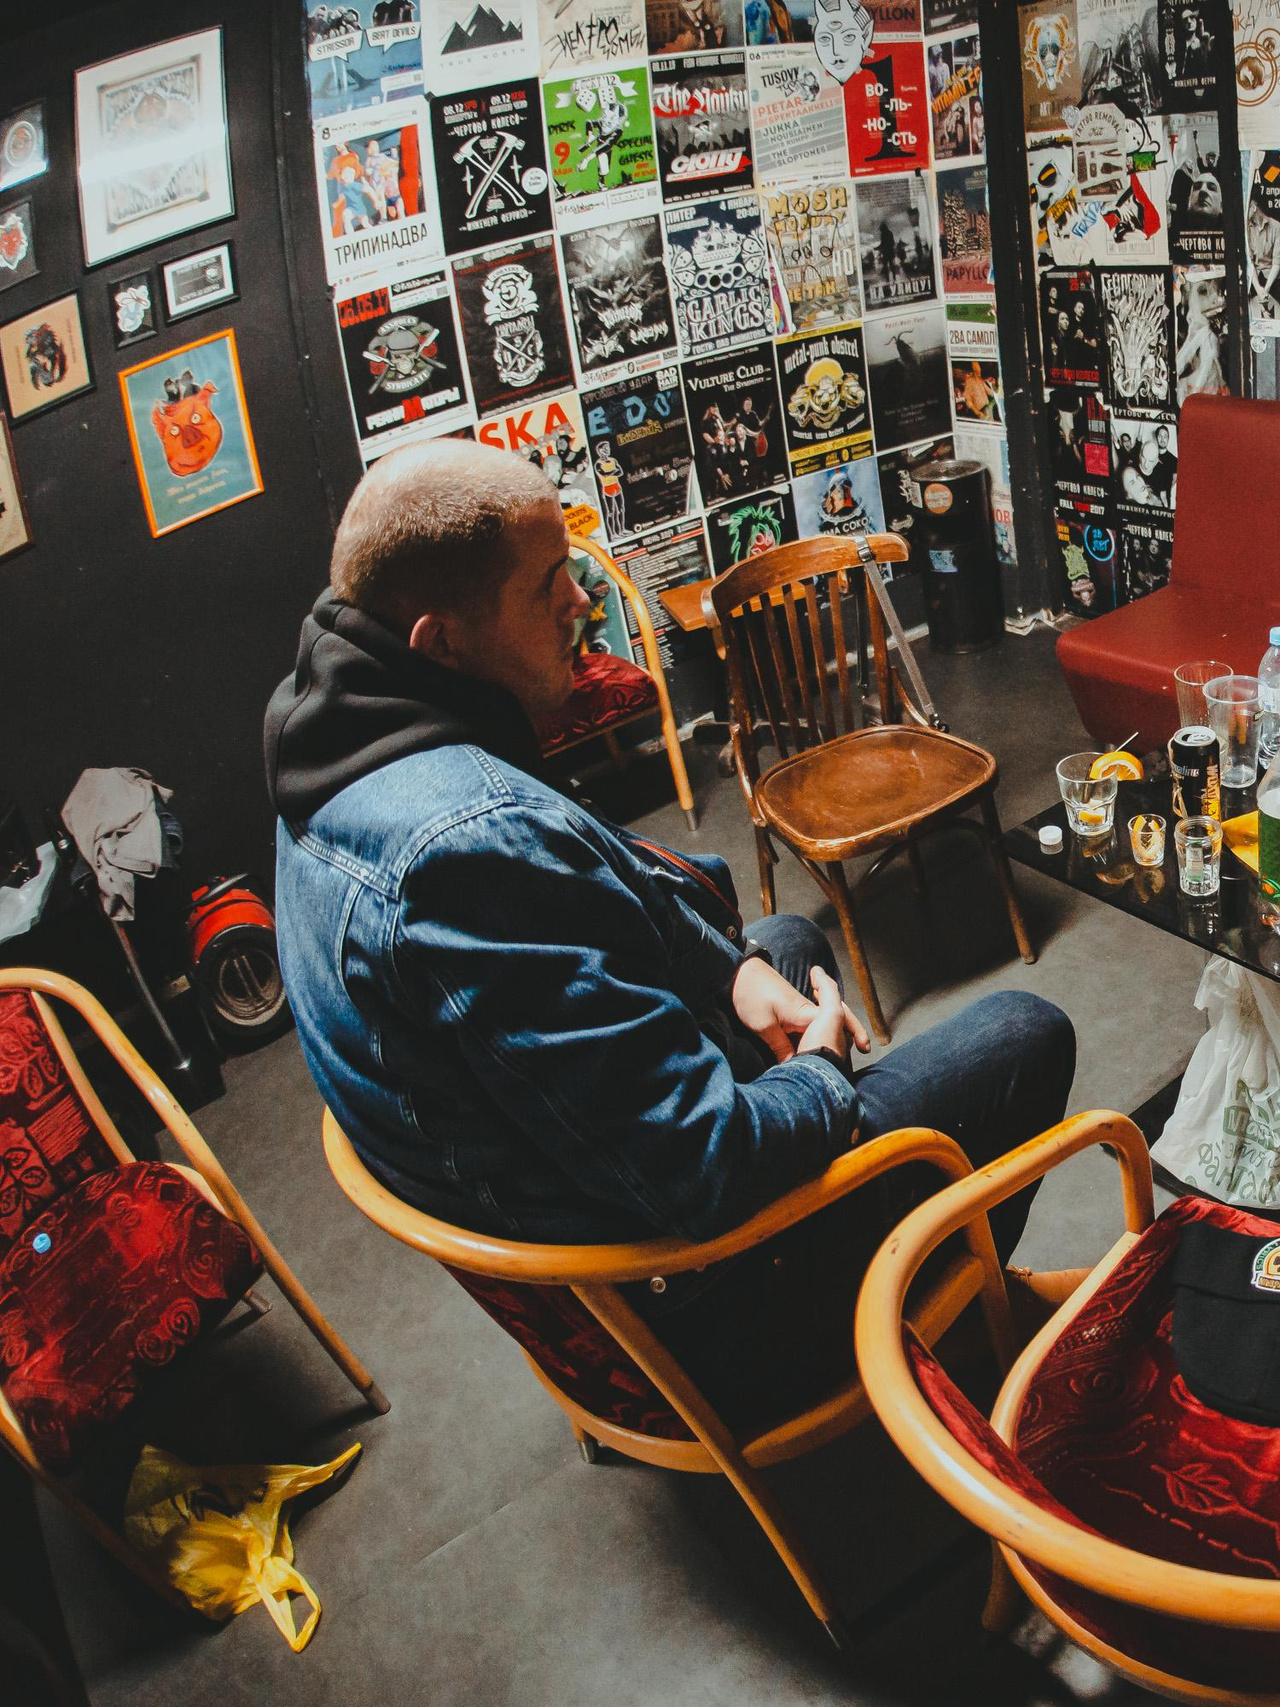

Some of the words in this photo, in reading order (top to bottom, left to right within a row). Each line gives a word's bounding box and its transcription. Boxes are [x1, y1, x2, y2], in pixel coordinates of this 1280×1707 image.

[762, 119, 801, 137] JUKKA
[1075, 114, 1096, 138] TATTOO
[1093, 111, 1122, 135] REMOVAL
[554, 141, 571, 166] 9
[771, 149, 788, 160] THE
[768, 187, 848, 217] MOSH
[1260, 185, 1265, 195] 7
[335, 224, 429, 266] ТРИПИНАДВА
[688, 286, 766, 323] GARLIC
[689, 303, 765, 342] KINGS
[950, 331, 965, 345] 2ВА
[656, 368, 678, 379] BAD
[657, 377, 679, 388] HAIR
[478, 402, 577, 451] SKA
[569, 514, 595, 530] BLACK
